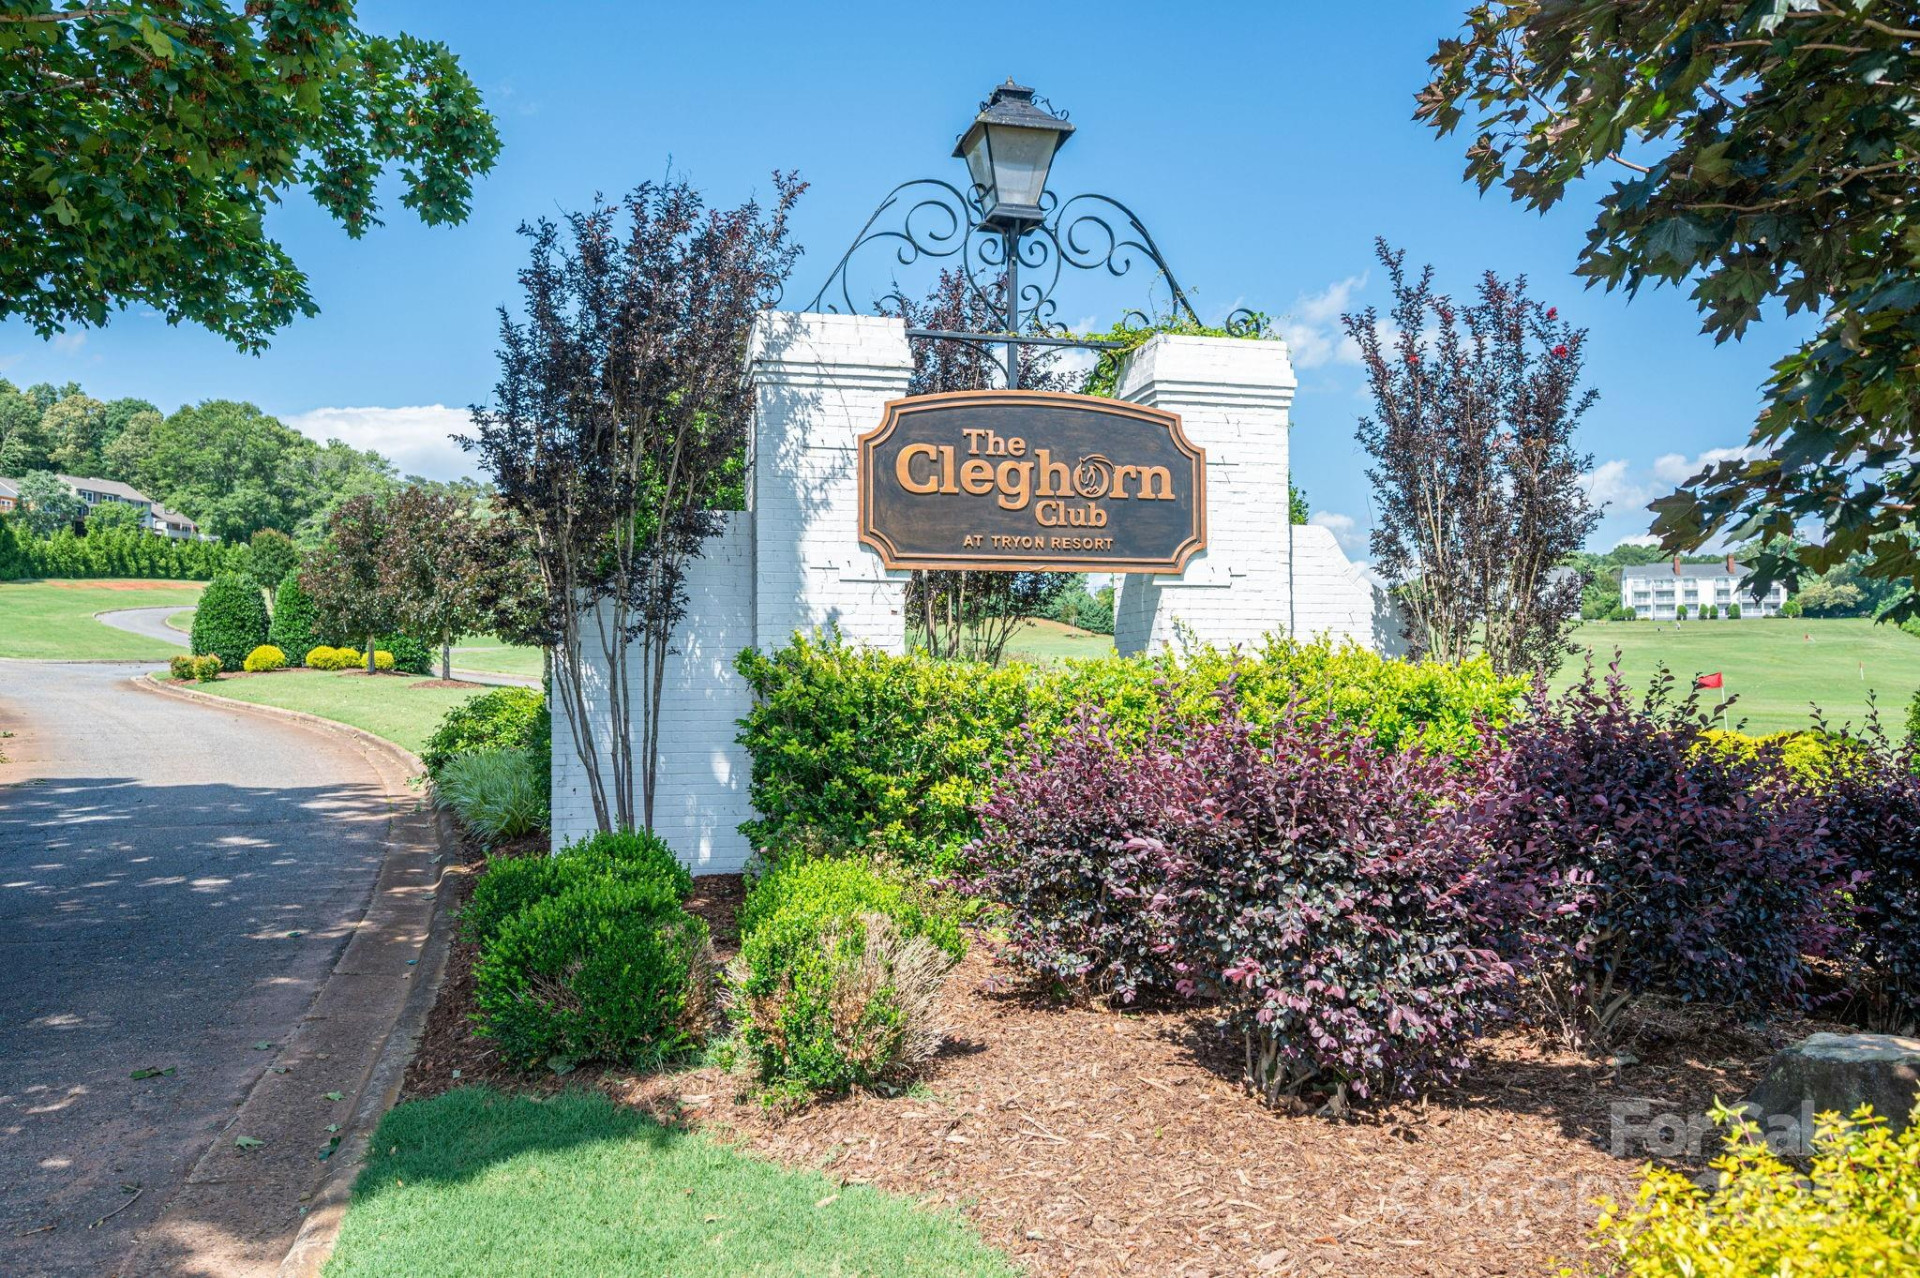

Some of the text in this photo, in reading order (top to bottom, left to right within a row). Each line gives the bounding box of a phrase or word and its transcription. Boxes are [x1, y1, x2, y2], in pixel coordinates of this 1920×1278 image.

[962, 428, 1026, 456] The
[895, 443, 1176, 510] Cleghorn
[1034, 500, 1108, 527] Club
[963, 535, 1114, 551] AT TRYON RESORT
